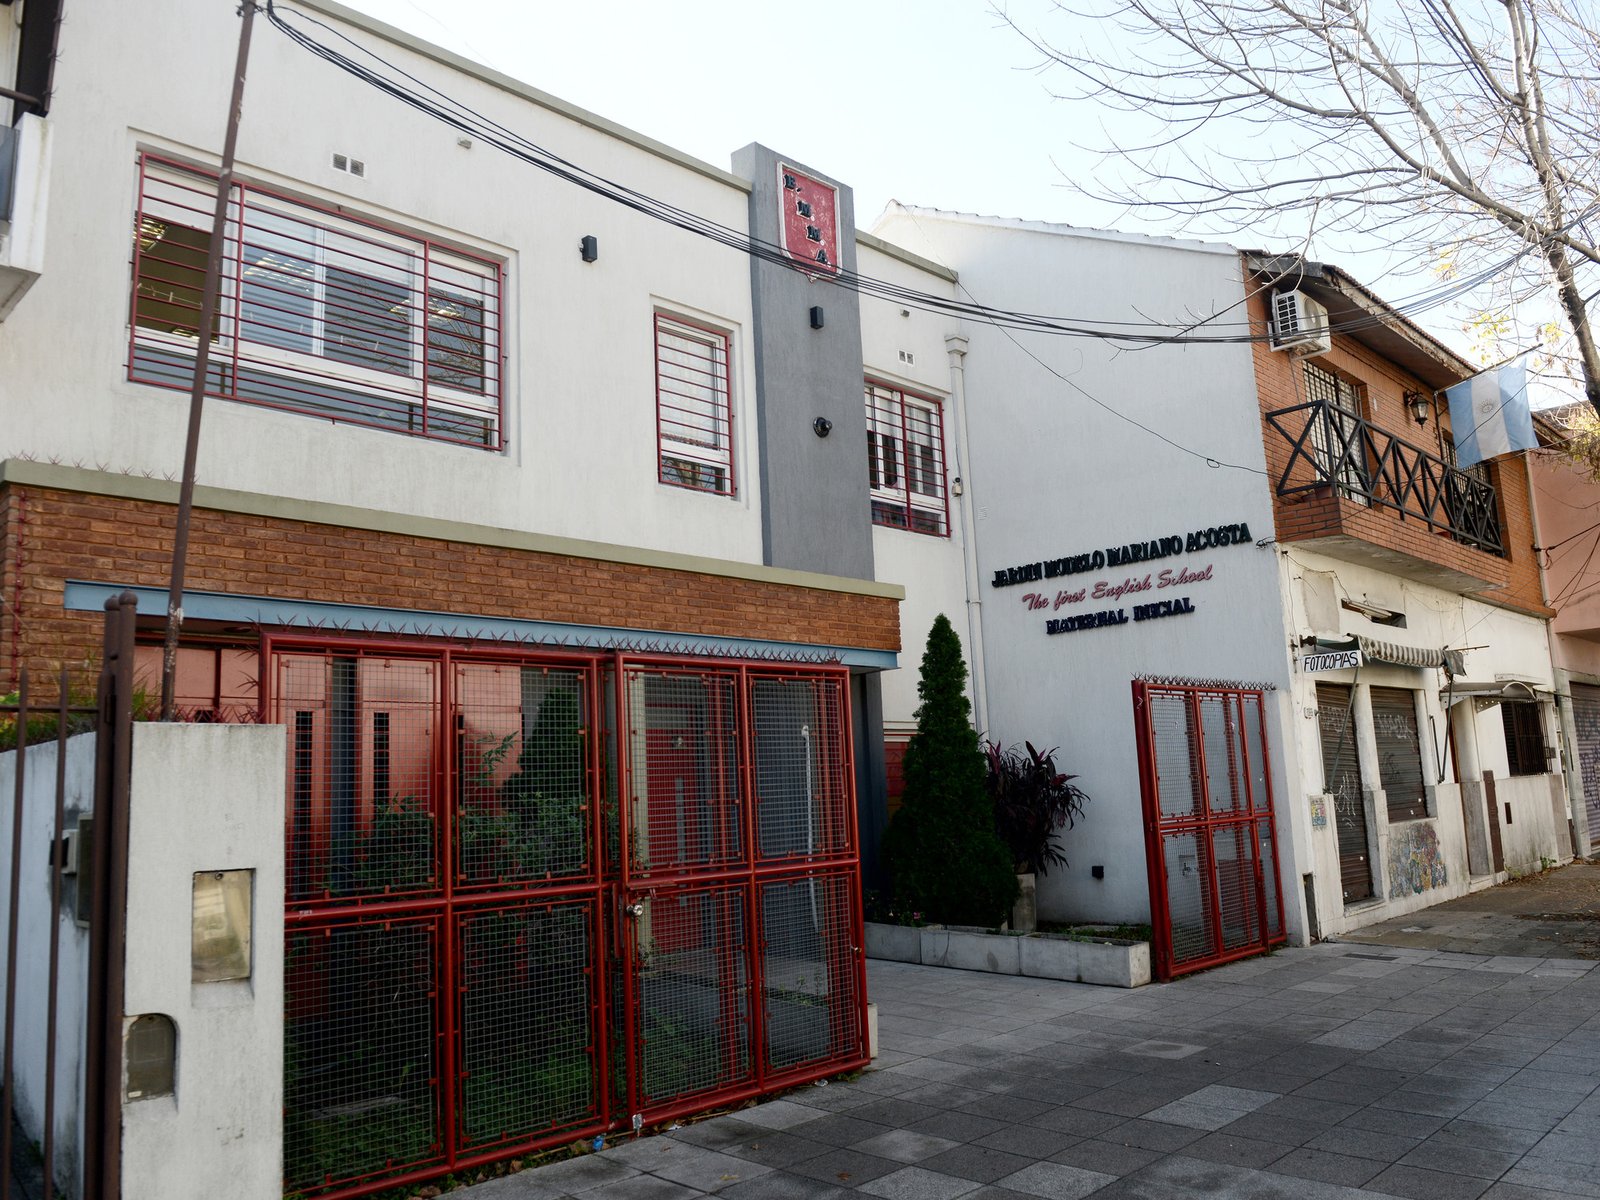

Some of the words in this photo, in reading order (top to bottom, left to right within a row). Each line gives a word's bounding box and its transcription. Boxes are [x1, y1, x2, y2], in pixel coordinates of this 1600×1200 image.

[1043, 550, 1105, 578] MODELO
[1106, 535, 1183, 567] MARIANO
[1185, 522, 1252, 553] ACOSTA
[1022, 592, 1049, 610] The
[1053, 587, 1087, 611] first
[1091, 574, 1152, 602] English
[1157, 564, 1213, 589] School
[1045, 608, 1129, 635] MATERNAL
[1133, 597, 1195, 622] INICIAL
[1304, 652, 1359, 672] FOTOCOPIAS
